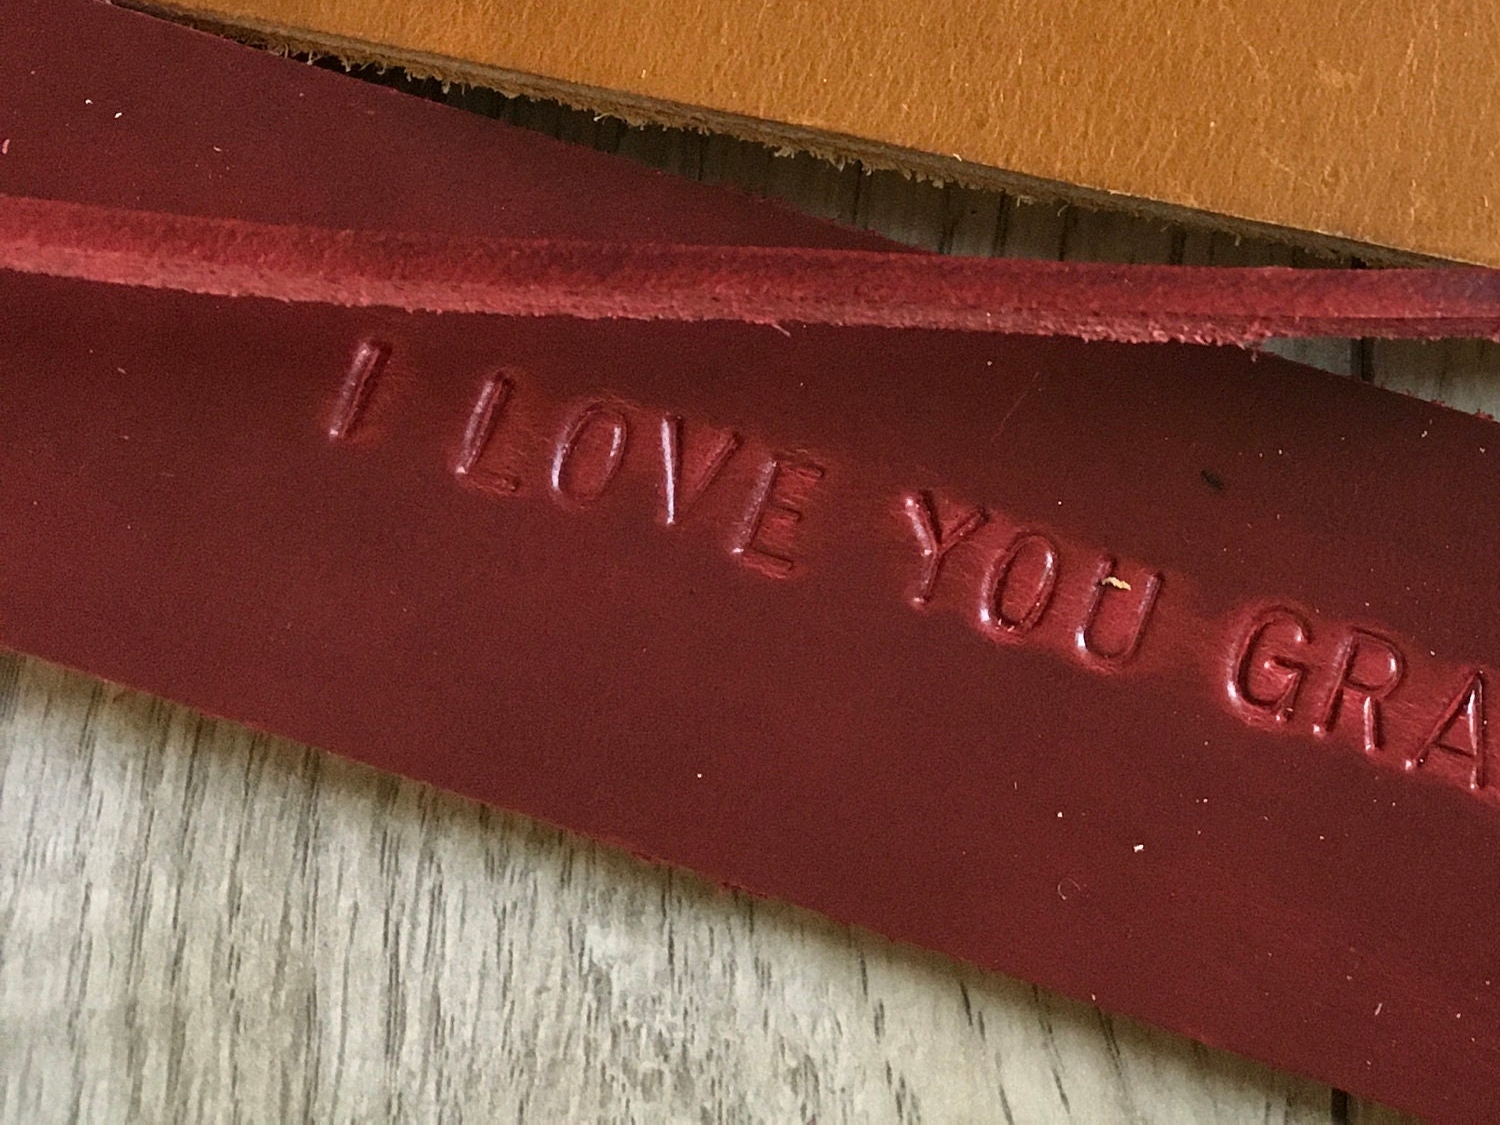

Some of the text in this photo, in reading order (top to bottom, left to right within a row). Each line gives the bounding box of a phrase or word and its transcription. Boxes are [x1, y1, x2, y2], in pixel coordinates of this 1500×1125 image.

[329, 339, 390, 442] I
[454, 372, 825, 579] LOVE
[904, 489, 1163, 667] YOU
